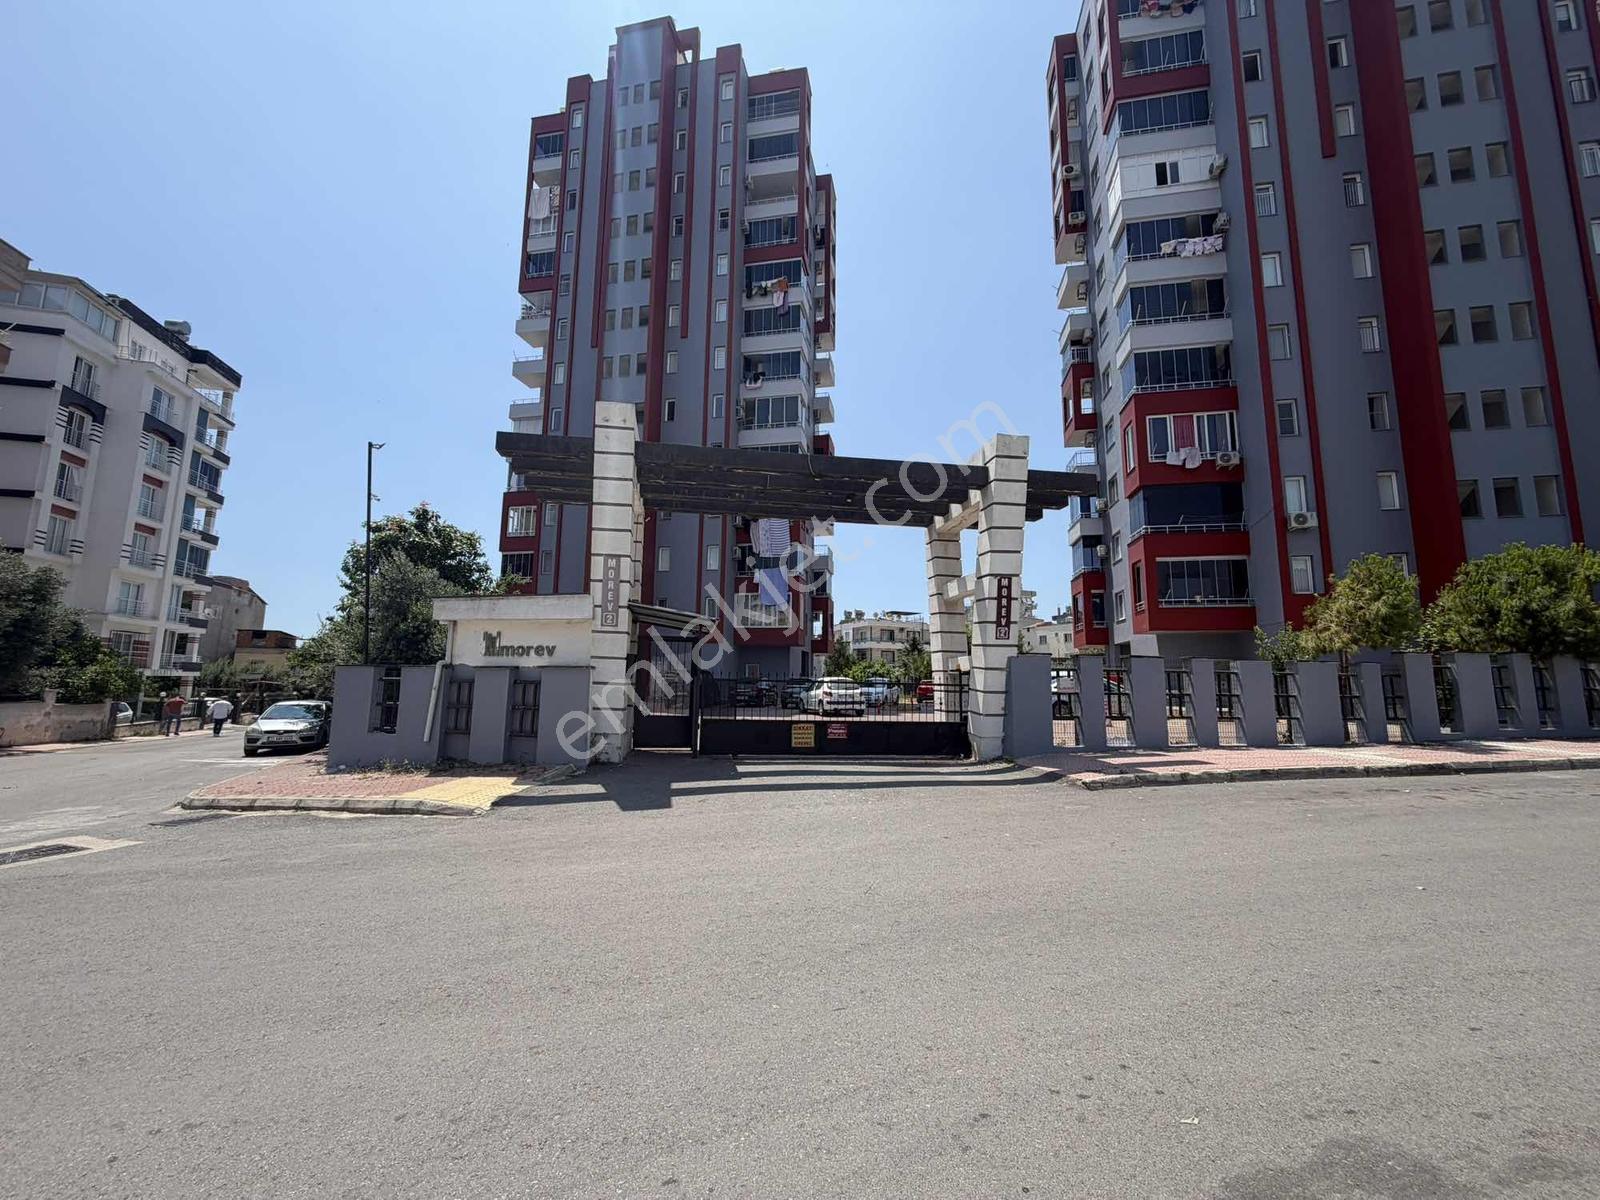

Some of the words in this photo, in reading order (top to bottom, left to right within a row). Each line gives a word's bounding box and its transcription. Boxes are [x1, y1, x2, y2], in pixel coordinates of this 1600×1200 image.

[607, 558, 616, 611] MOREV
[1001, 578, 1009, 626] MOREV
[500, 644, 557, 657] morev
